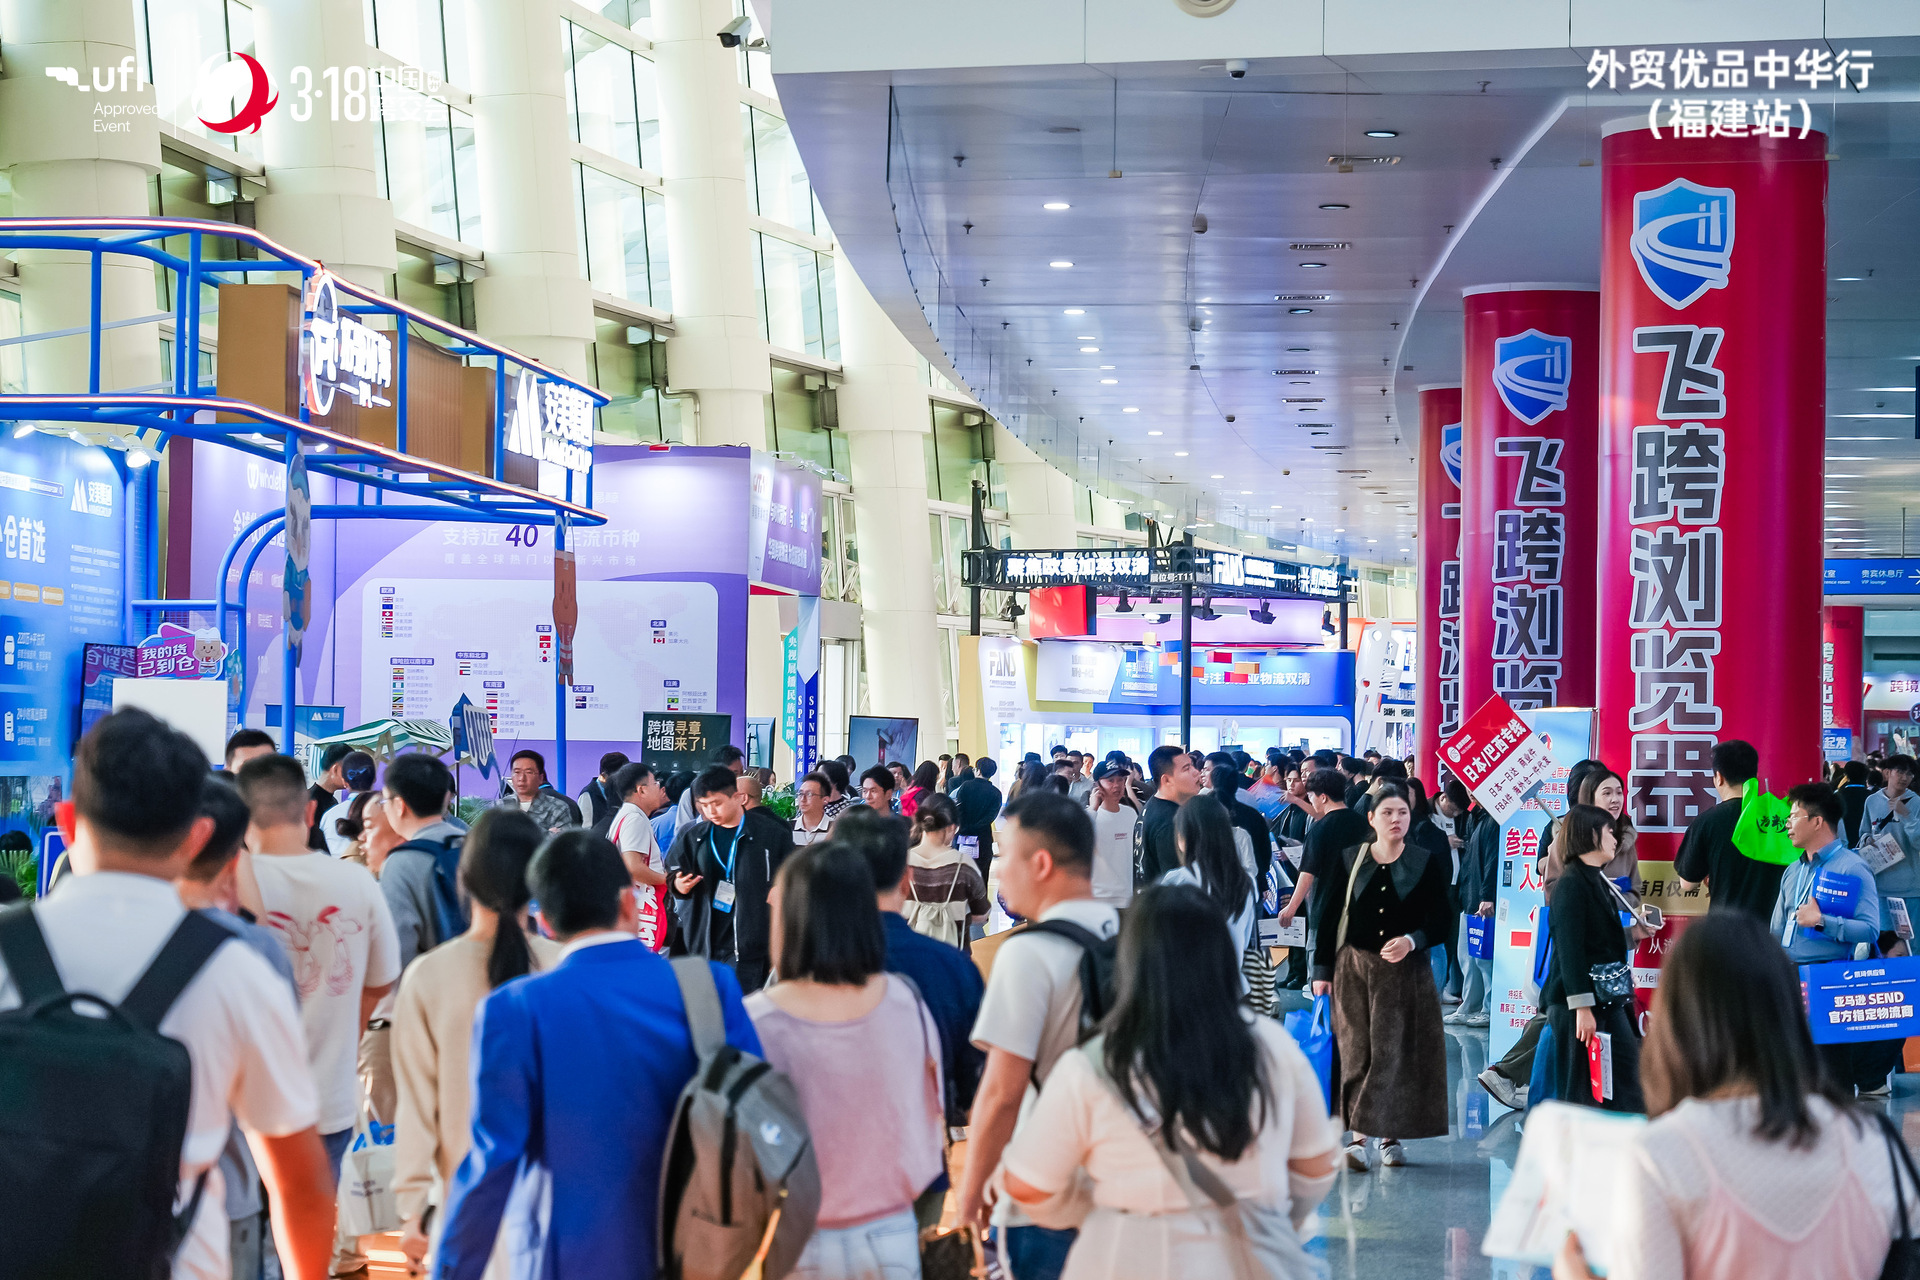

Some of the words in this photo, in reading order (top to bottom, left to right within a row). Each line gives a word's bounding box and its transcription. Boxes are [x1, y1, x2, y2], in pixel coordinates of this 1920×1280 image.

[545, 380, 594, 448] 安美集团
[0, 514, 46, 564] 仓首选
[442, 527, 499, 547] 支持近
[505, 524, 539, 548] 40
[444, 553, 637, 567] 覆盖全球热门以新兴市场
[1006, 557, 1150, 578] 聚焦欧美加英双清
[1628, 325, 1728, 834] 飞跨浏览器
[1861, 569, 1904, 579] 贵宾休息厅
[141, 642, 188, 661] 我的货
[137, 655, 196, 678] 已到仓
[785, 635, 798, 741] 央视展播民族品牌
[1198, 672, 1311, 686] 专注亚物流双清
[1889, 679, 1920, 694] 跨境
[646, 720, 702, 736] 跨境寻章
[1462, 717, 1528, 784] 日本/巴西专线
[1488, 765, 1521, 799] 日本一日达
[1517, 747, 1539, 769] 商业件
[1495, 792, 1514, 814] FBA件
[1511, 755, 1553, 796] 海外仓一件代发
[1504, 827, 1539, 858] 参会
[1833, 994, 1868, 1009] 亚马逊
[1868, 991, 1905, 1006] SEND
[1827, 1003, 1915, 1025] 官方指定物流商
